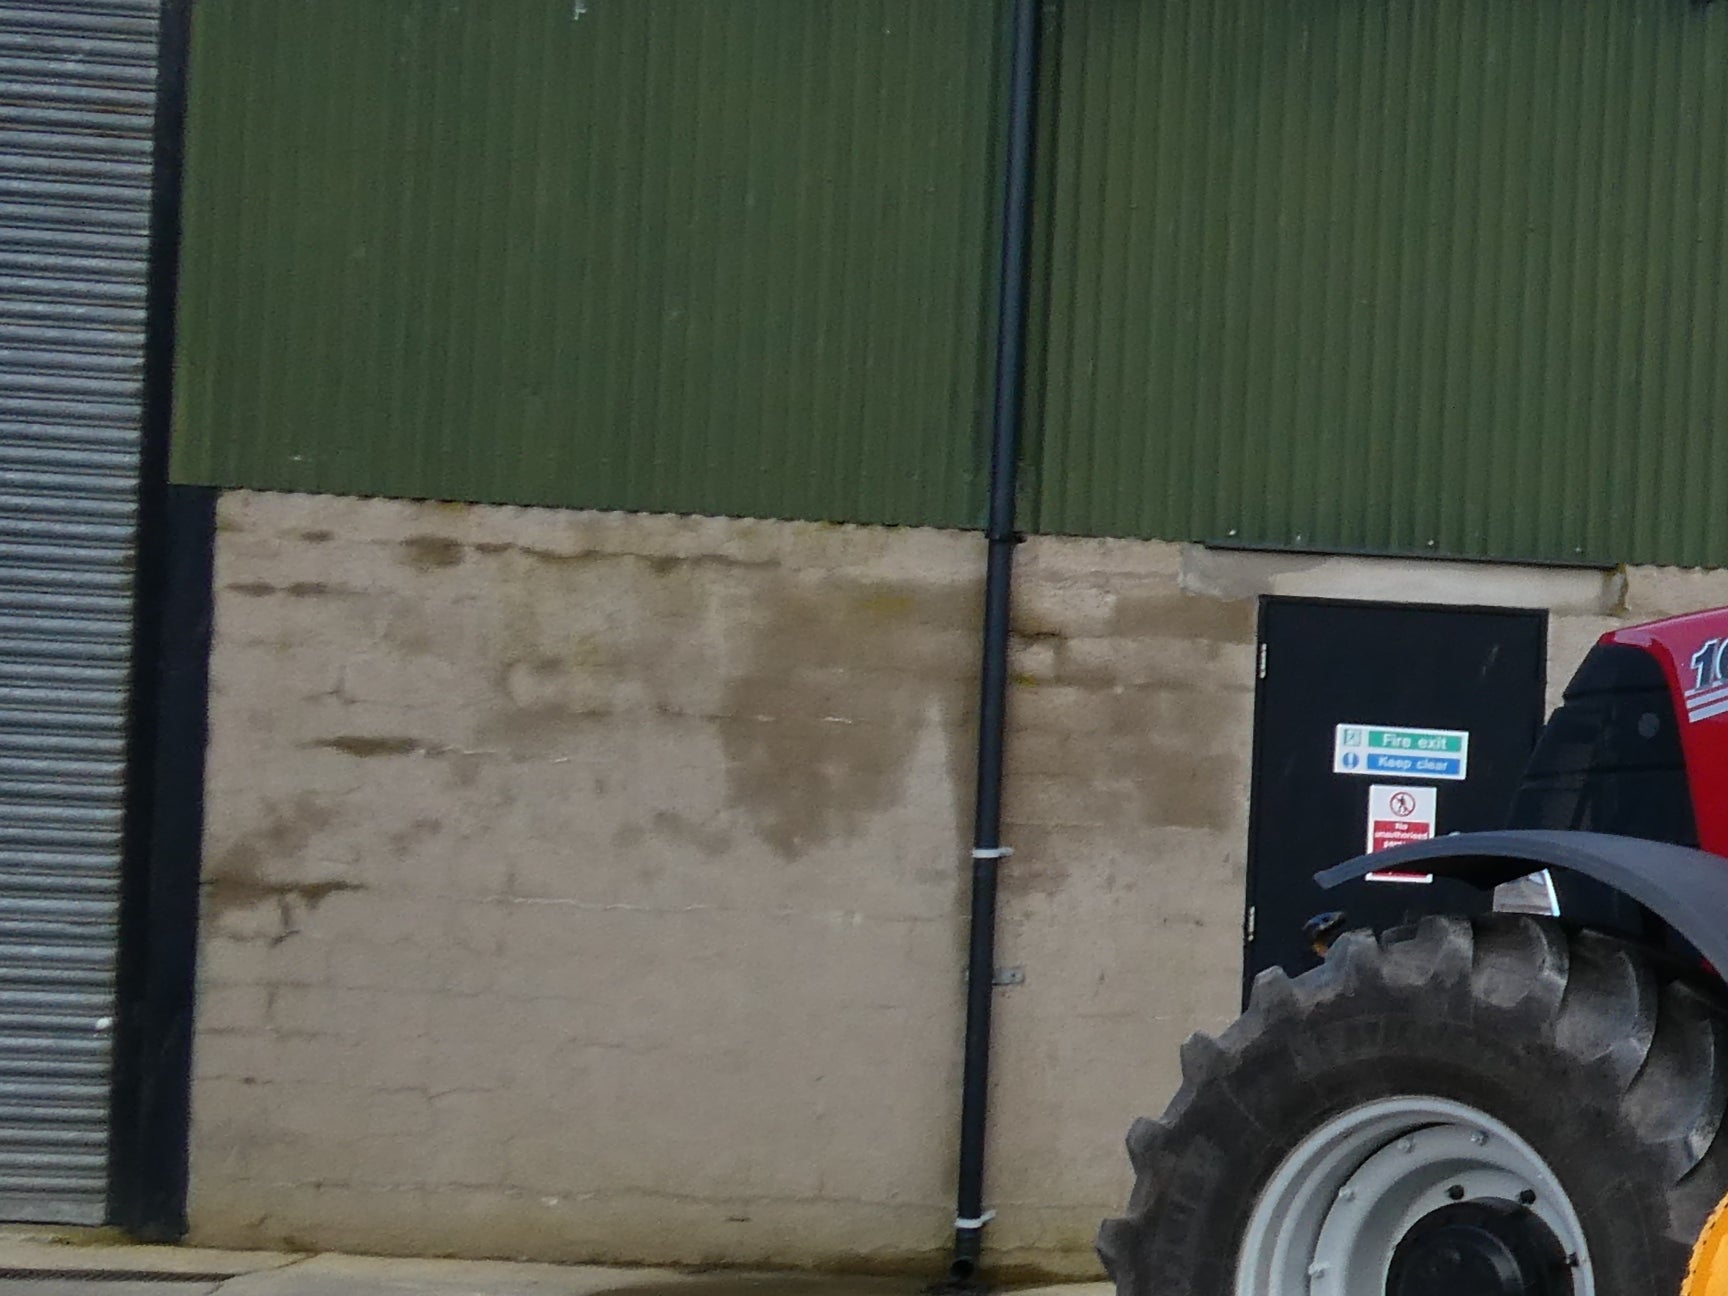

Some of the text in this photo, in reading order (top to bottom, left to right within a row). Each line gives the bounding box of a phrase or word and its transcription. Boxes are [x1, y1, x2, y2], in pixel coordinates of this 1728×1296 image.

[1382, 733, 1448, 750] Fire exit
[1378, 756, 1448, 771] Keep clear
